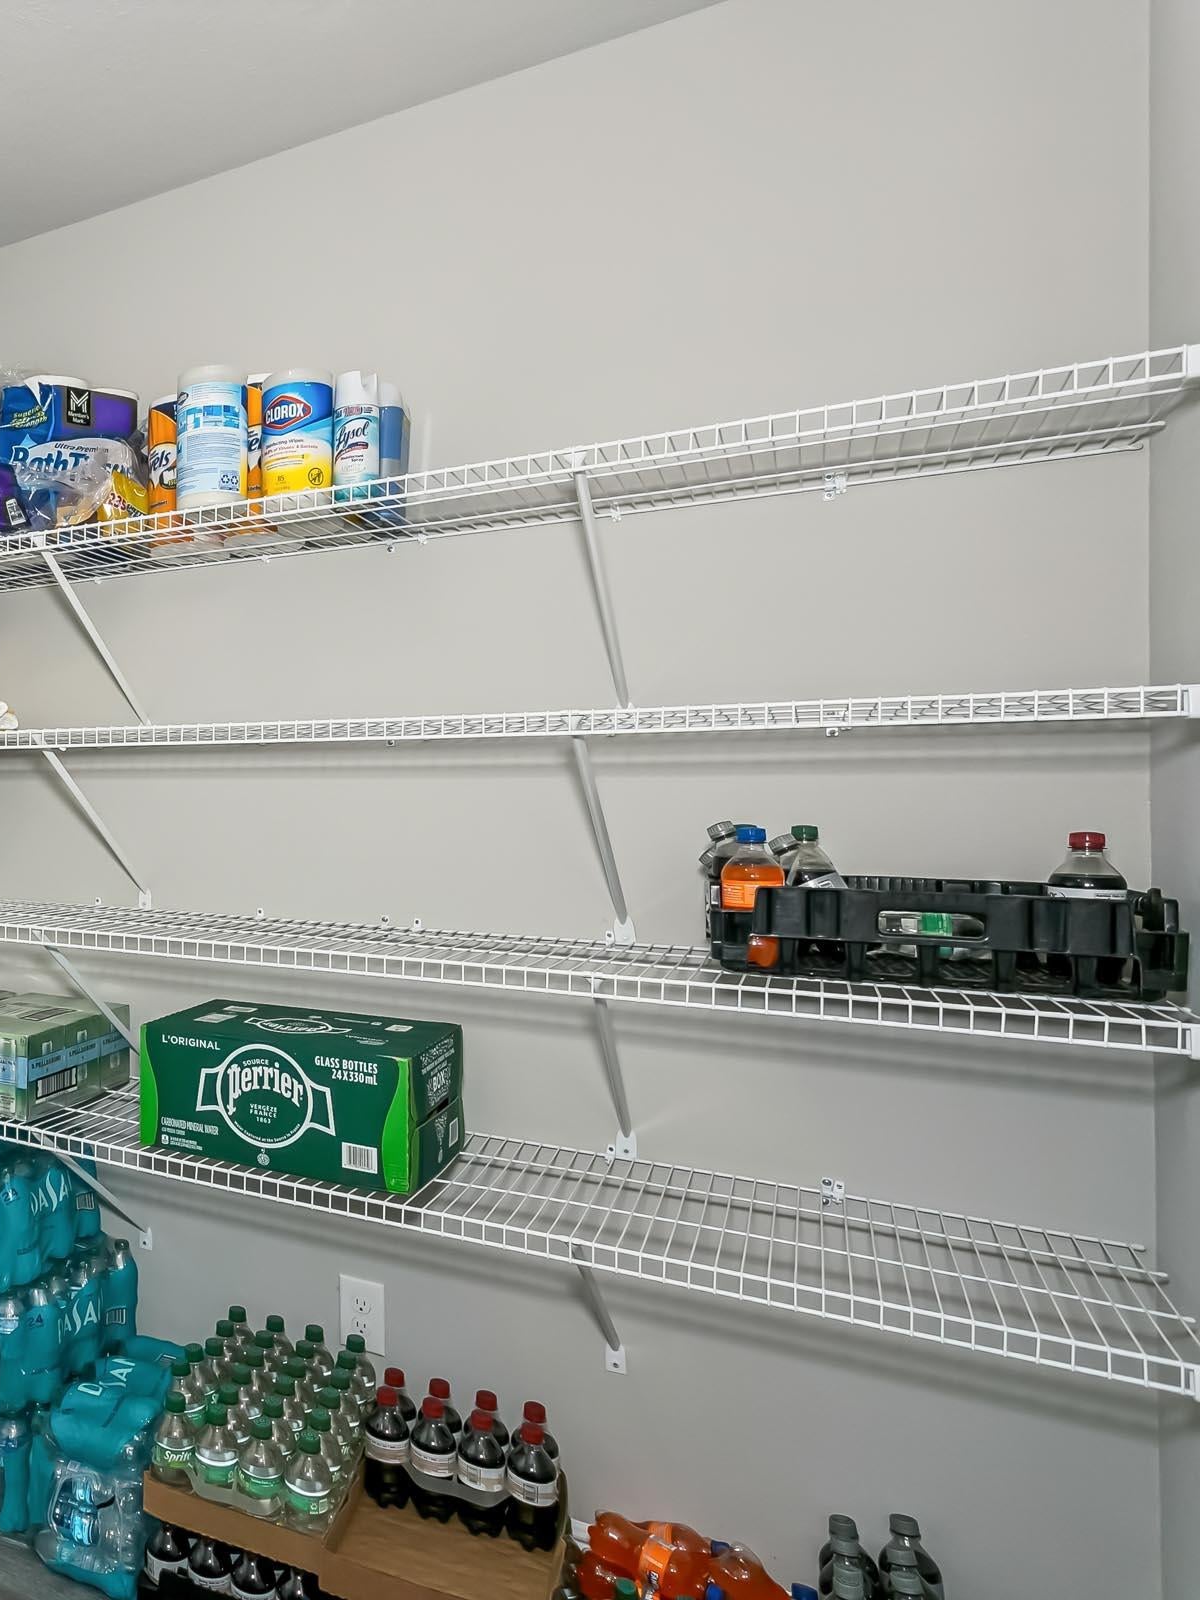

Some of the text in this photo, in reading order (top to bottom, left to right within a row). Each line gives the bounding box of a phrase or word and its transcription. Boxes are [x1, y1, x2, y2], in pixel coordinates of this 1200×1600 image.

[265, 403, 305, 425] CLOROX
[336, 420, 370, 452] Lysol
[55, 442, 76, 451] Ultra
[162, 1034, 221, 1051] L'ORIGINAL
[242, 1058, 269, 1067] SOURCE
[314, 1055, 378, 1074] GLASS BOTTLES
[249, 1109, 277, 1119] FRANCE
